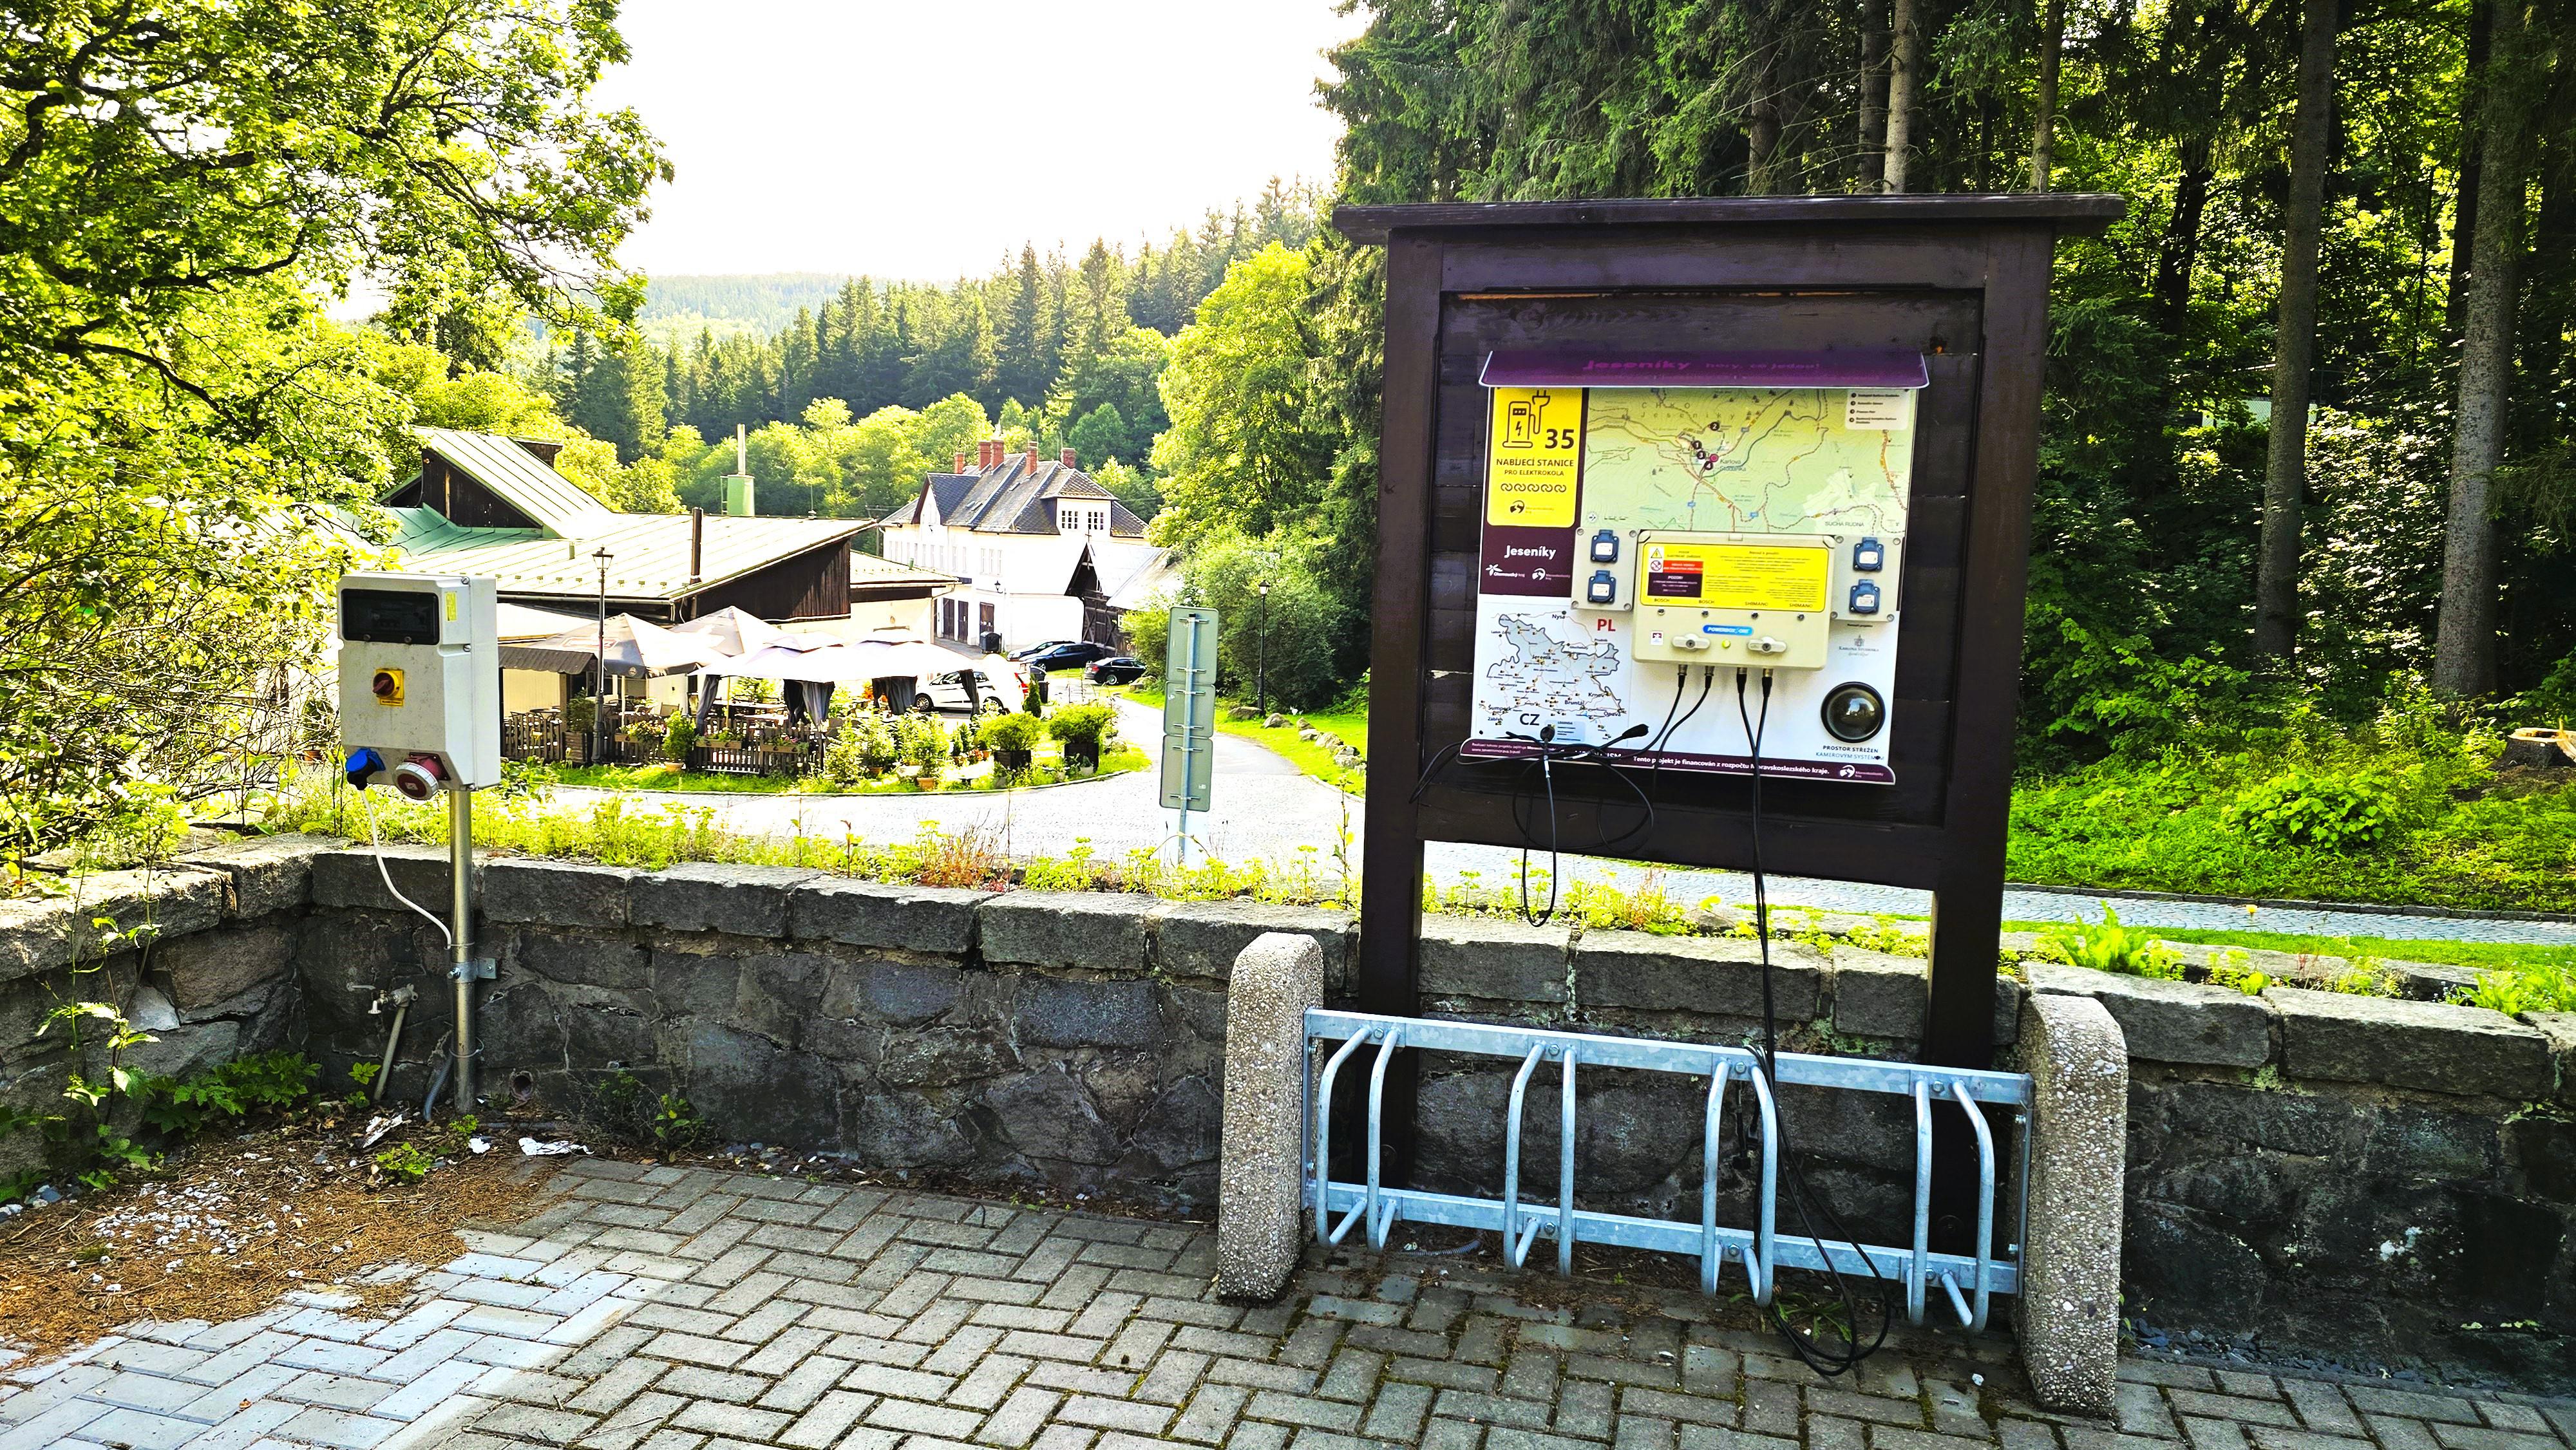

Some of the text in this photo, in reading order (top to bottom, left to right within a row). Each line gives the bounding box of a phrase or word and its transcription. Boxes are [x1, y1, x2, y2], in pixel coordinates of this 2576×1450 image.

[1545, 428, 1575, 449] 35
[1496, 457, 1535, 466] NABÍJECÍ
[1504, 545, 1557, 560] Jeseníky
[1597, 619, 1616, 632] PL
[1520, 713, 1540, 726] CZ
